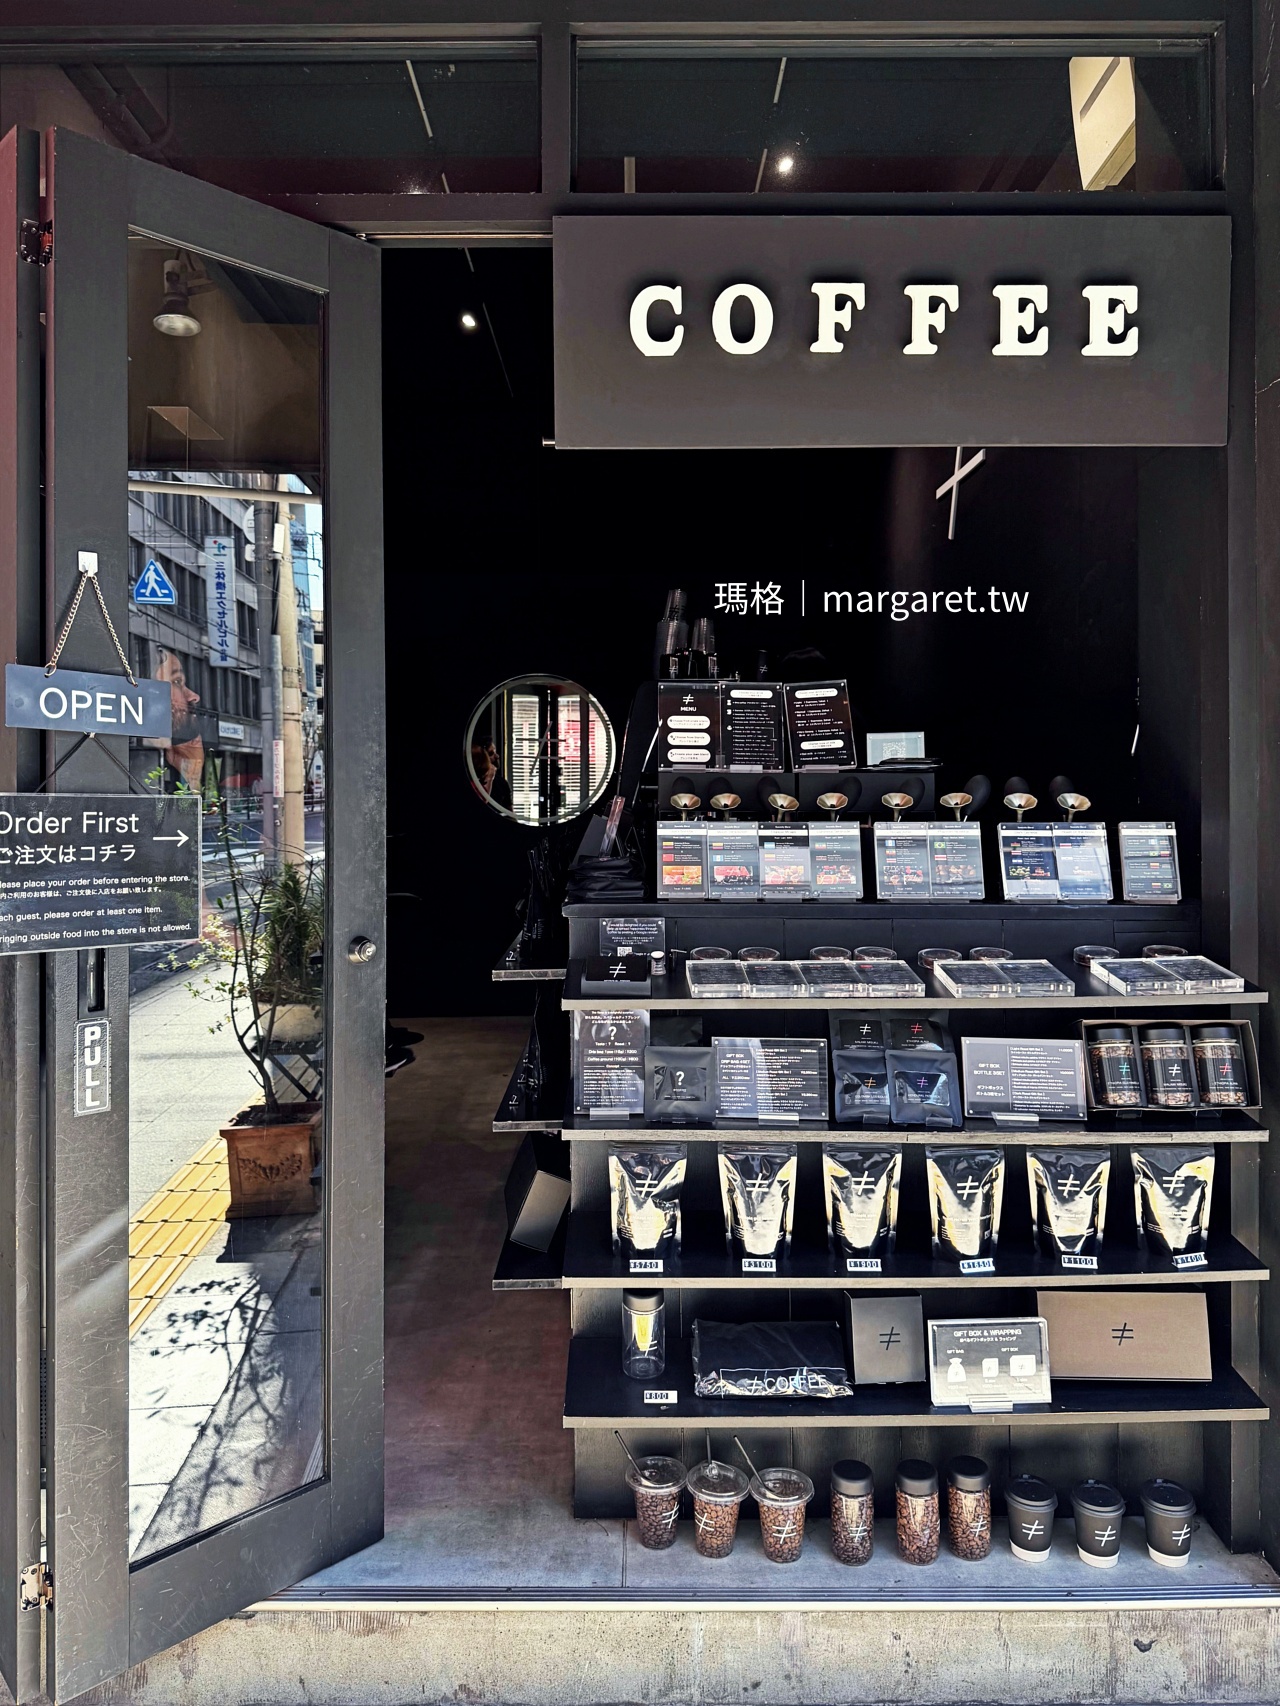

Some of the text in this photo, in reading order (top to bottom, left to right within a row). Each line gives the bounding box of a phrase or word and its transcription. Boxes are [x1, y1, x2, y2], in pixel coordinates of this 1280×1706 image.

[629, 282, 1138, 357] COFFEE
[39, 686, 145, 725] OPEN
[0, 811, 139, 834] Order First
[0, 845, 136, 865] ご注文はコチラ
[0, 874, 191, 890] lease place your order before entering the store.
[0, 905, 163, 923] ach guest, please order at least one item.
[0, 923, 192, 943] ringing outside food into the store is not allowed.
[84, 1026, 101, 1108] PULL
[953, 1329, 1022, 1337] GIFT BOX & WRAPPING
